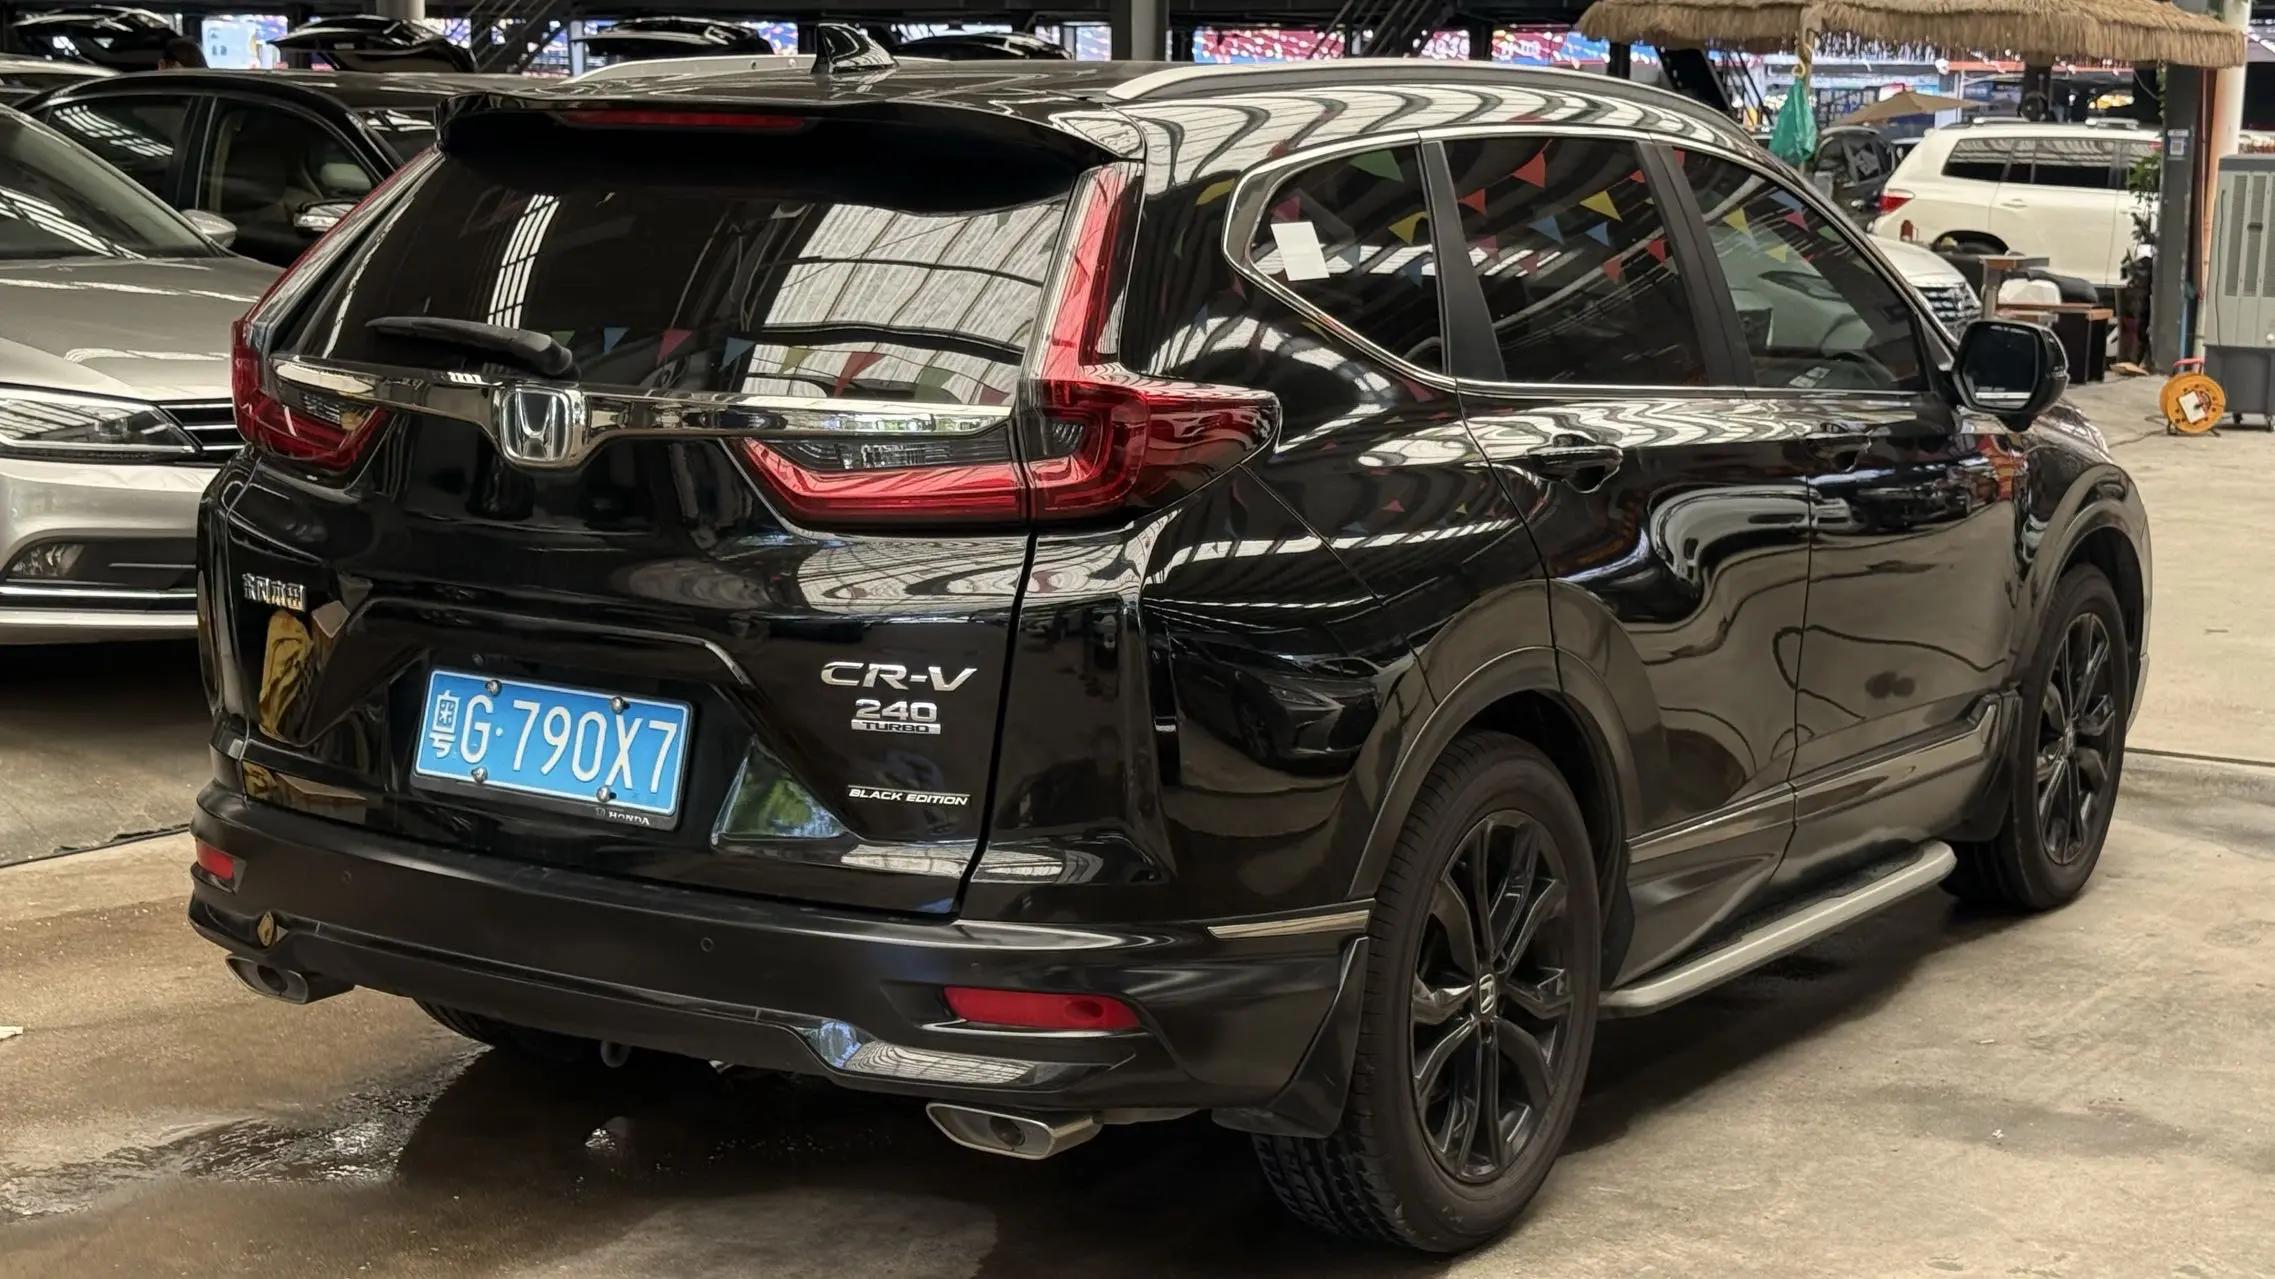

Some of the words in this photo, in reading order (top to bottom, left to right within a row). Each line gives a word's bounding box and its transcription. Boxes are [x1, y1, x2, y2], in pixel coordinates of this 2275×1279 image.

[820, 661, 978, 692] CR-V
[855, 698, 938, 723] 240
[862, 721, 930, 734] TURBO
[849, 788, 903, 801] BLACK
[905, 793, 969, 806] EDITION
[608, 810, 650, 826] HONDA
